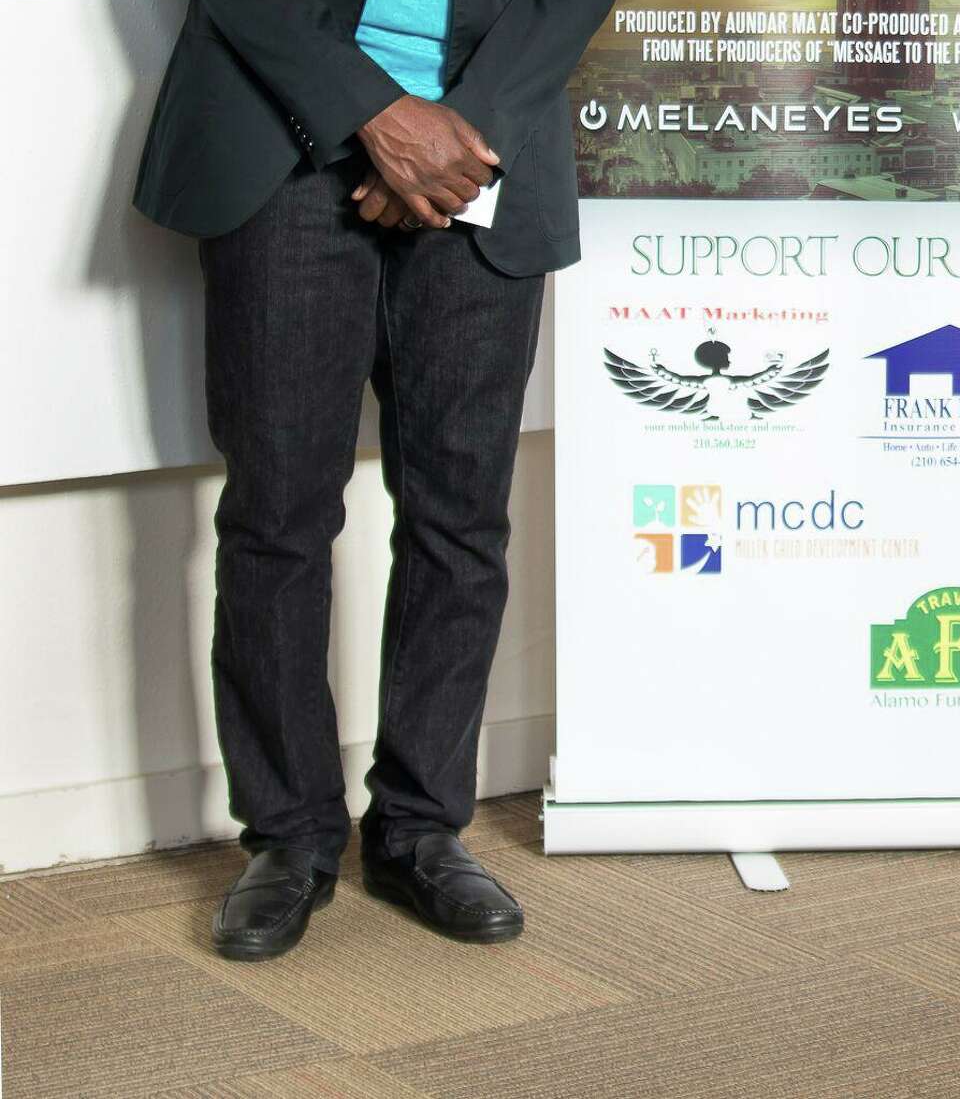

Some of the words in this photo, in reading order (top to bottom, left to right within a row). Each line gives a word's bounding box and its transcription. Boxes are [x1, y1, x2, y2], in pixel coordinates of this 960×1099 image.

[615, 10, 696, 33] PRODUCED
[700, 10, 720, 33] BY
[725, 11, 788, 34] AUNDAR
[792, 11, 837, 35] MA'AT
[843, 12, 948, 36] CO-PRODUCED
[642, 40, 684, 62] FROM
[687, 40, 714, 62] THE
[717, 40, 801, 63] PRODUCERS
[805, 40, 823, 63] OF
[903, 42, 921, 64] TO
[925, 42, 950, 65] THE
[617, 104, 903, 133] MELANEYES
[630, 235, 839, 277] SUPPORT
[852, 236, 960, 278] OUR
[609, 307, 692, 320] MAAT
[703, 307, 829, 321] Marketing
[884, 398, 952, 418] FRANK
[884, 422, 956, 432] Insurance
[883, 442, 907, 452] Home
[914, 443, 934, 452] Auto
[942, 442, 957, 452] Life
[911, 456, 937, 468] (210)
[736, 489, 865, 531] mcdc
[870, 692, 929, 708] Alamo
